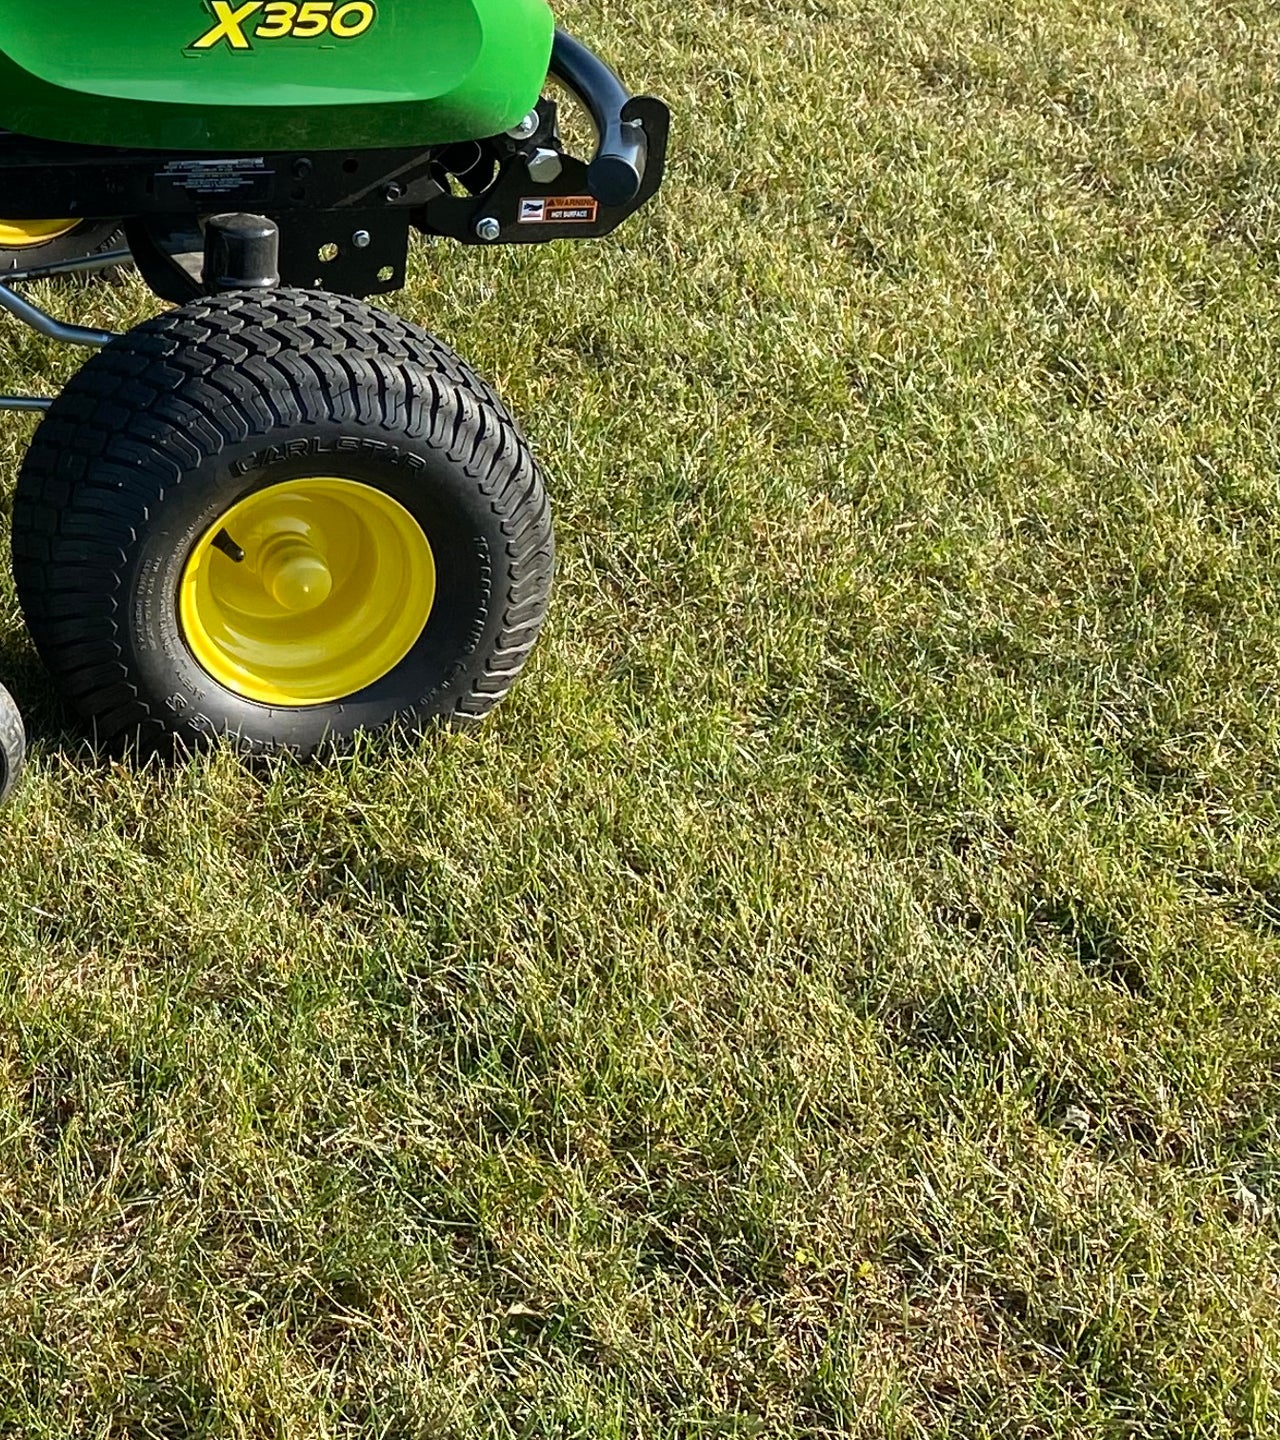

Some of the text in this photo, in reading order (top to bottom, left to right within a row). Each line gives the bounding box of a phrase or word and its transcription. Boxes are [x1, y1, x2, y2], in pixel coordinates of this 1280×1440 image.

[190, 0, 376, 50] X350
[555, 198, 596, 207] WARNING
[228, 435, 427, 478] CARLSTAR
